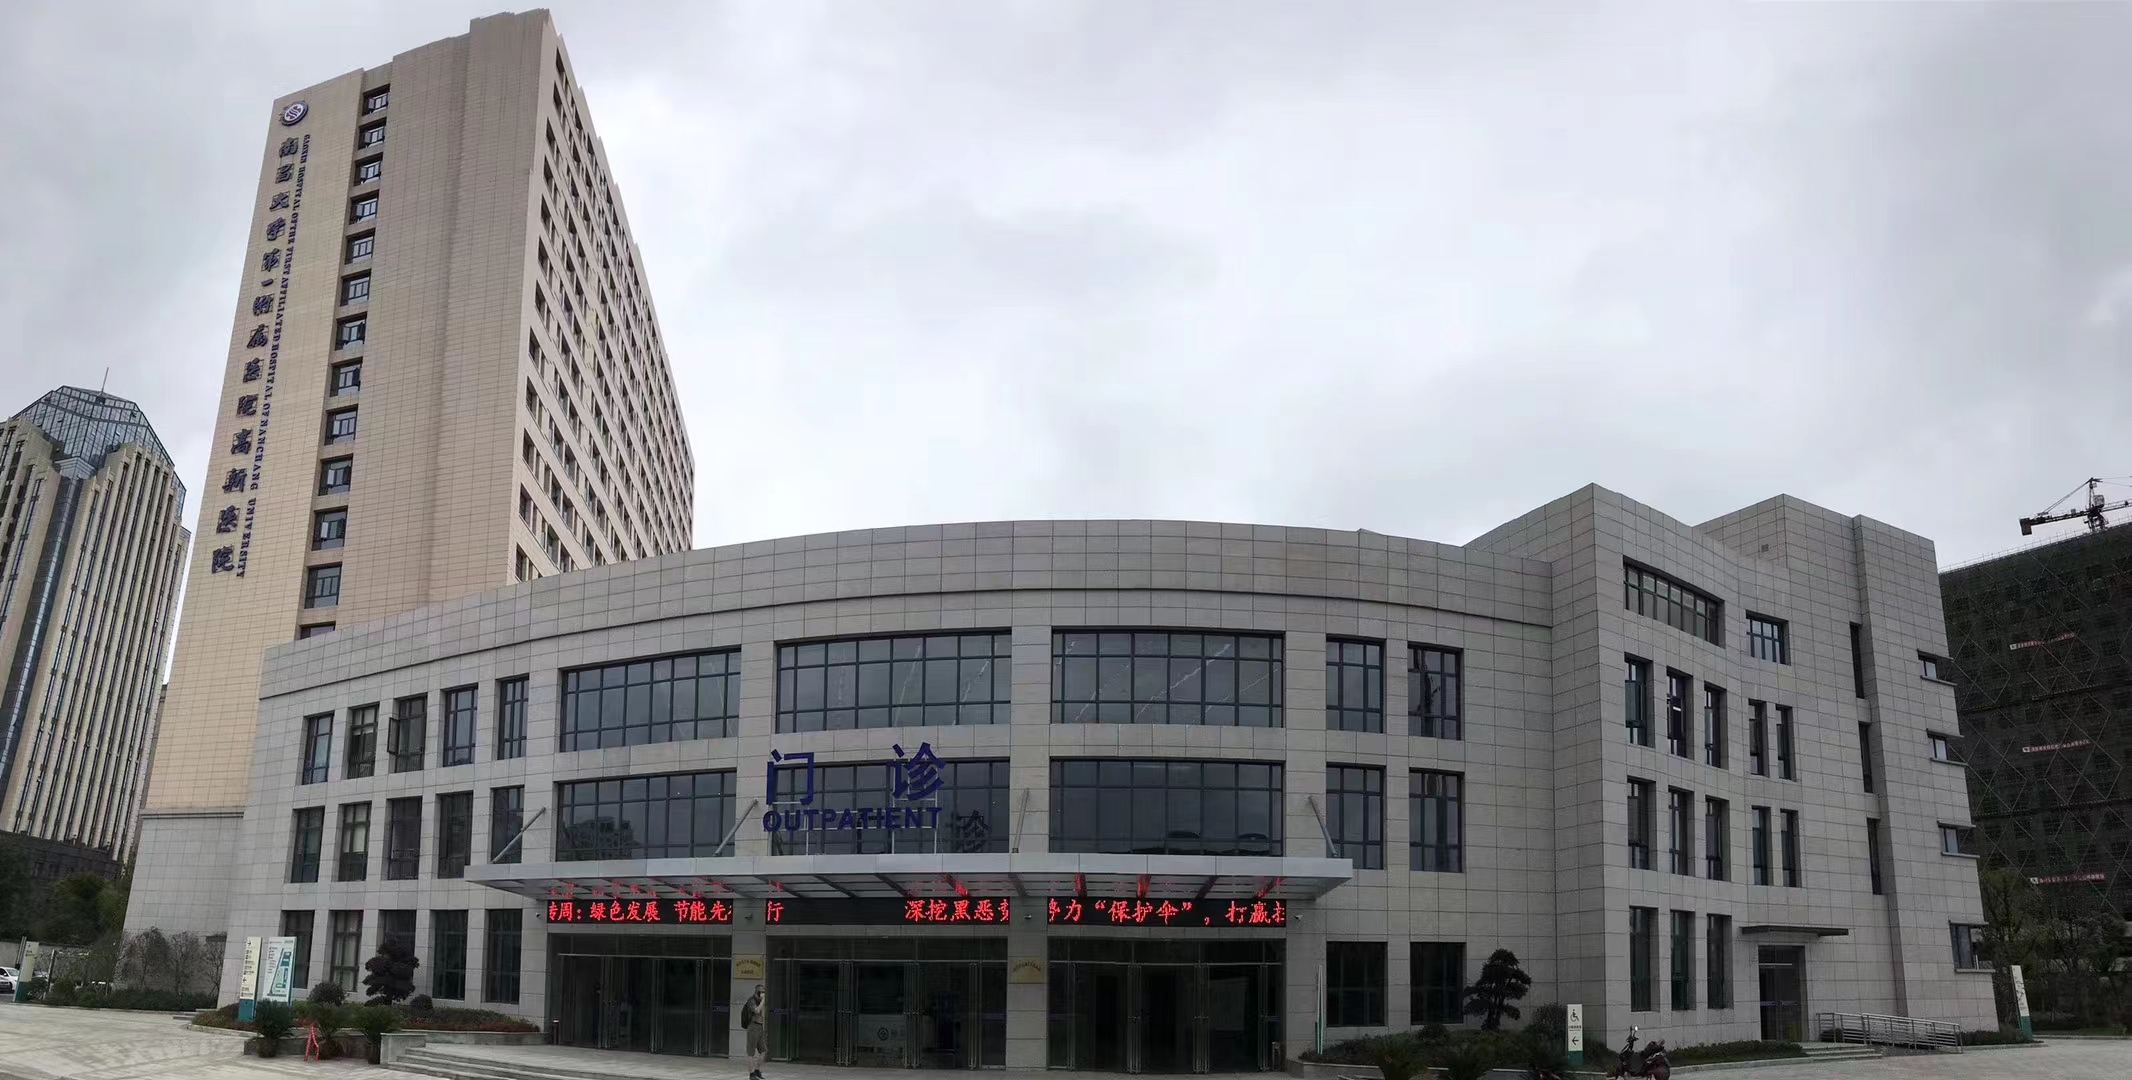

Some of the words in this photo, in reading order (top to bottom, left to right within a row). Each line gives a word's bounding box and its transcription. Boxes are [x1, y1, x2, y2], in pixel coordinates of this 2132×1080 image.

[300, 134, 311, 164] GAOXIN
[293, 166, 306, 211] HOSPITAL
[283, 246, 294, 275] FIRST
[273, 277, 289, 342] AFFILIATED
[264, 343, 280, 401] HOSPITAL
[250, 416, 269, 491] NANCHANG
[236, 497, 257, 578] UNIVERSITY
[766, 742, 946, 805] 门诊
[762, 807, 943, 832] OUTPATIENT
